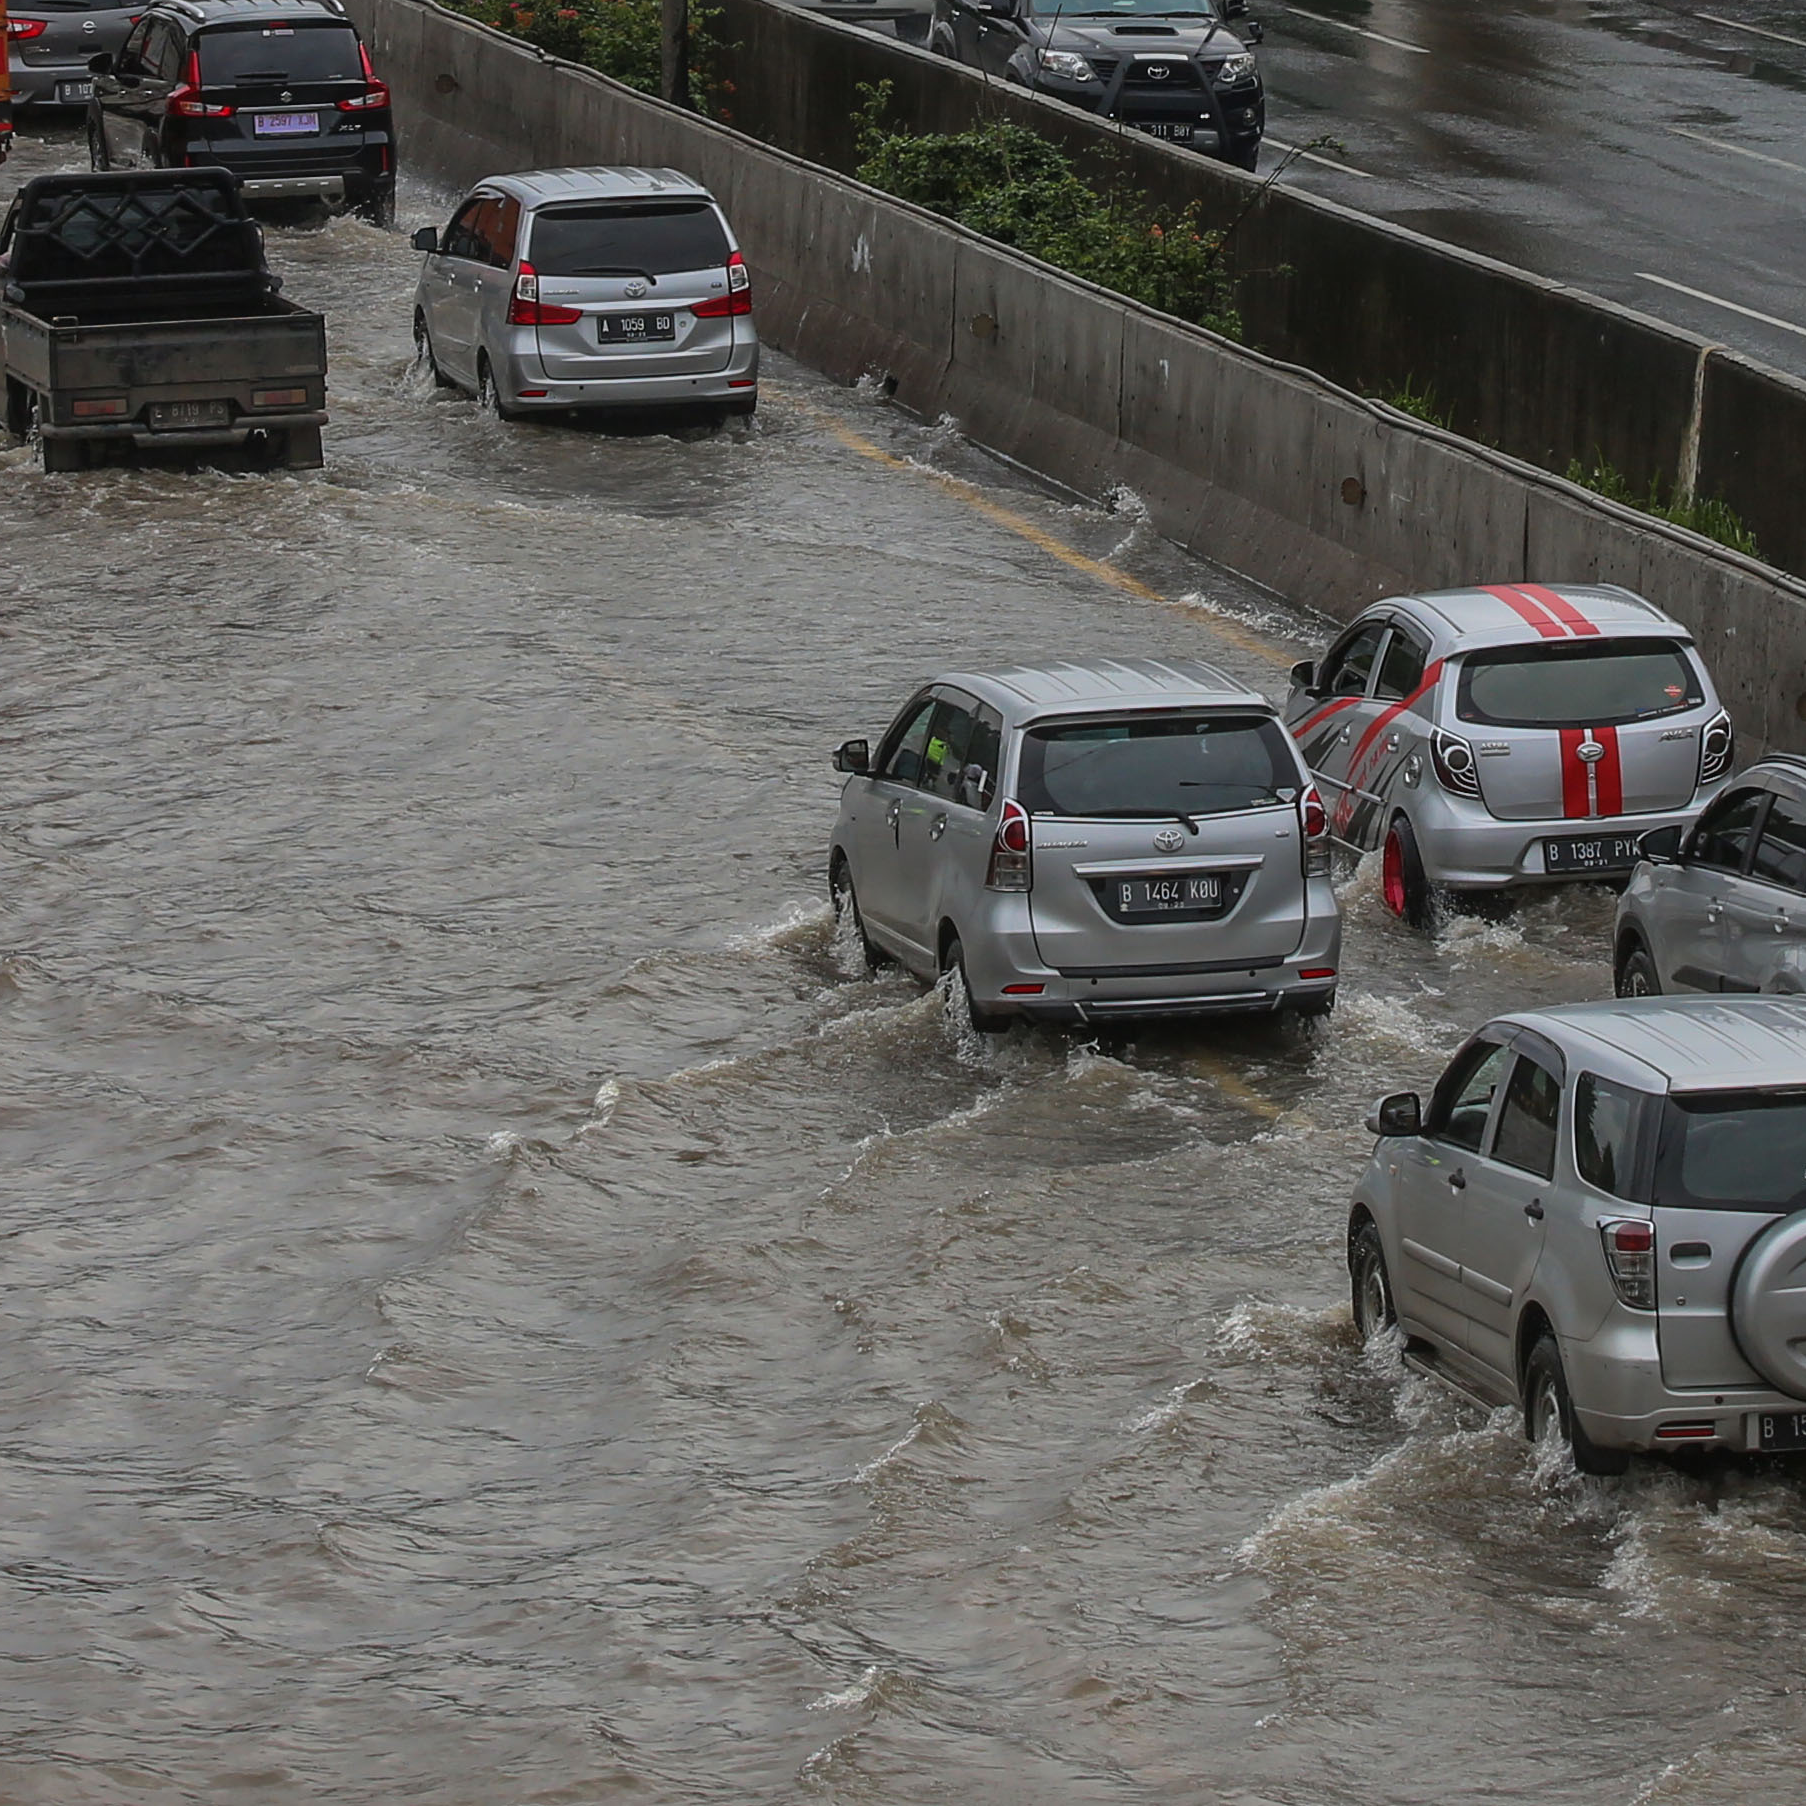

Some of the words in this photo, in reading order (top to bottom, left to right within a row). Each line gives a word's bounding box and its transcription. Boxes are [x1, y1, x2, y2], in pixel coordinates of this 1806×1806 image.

[257, 116, 265, 128] B
[602, 319, 610, 333] A
[620, 318, 645, 332] 1059
[1548, 843, 1560, 862] B
[1570, 841, 1602, 860] 1387
[1614, 839, 1642, 857] PYK
[1122, 883, 1132, 903] B
[1144, 881, 1179, 902] 1464
[1763, 1416, 1774, 1439] B
